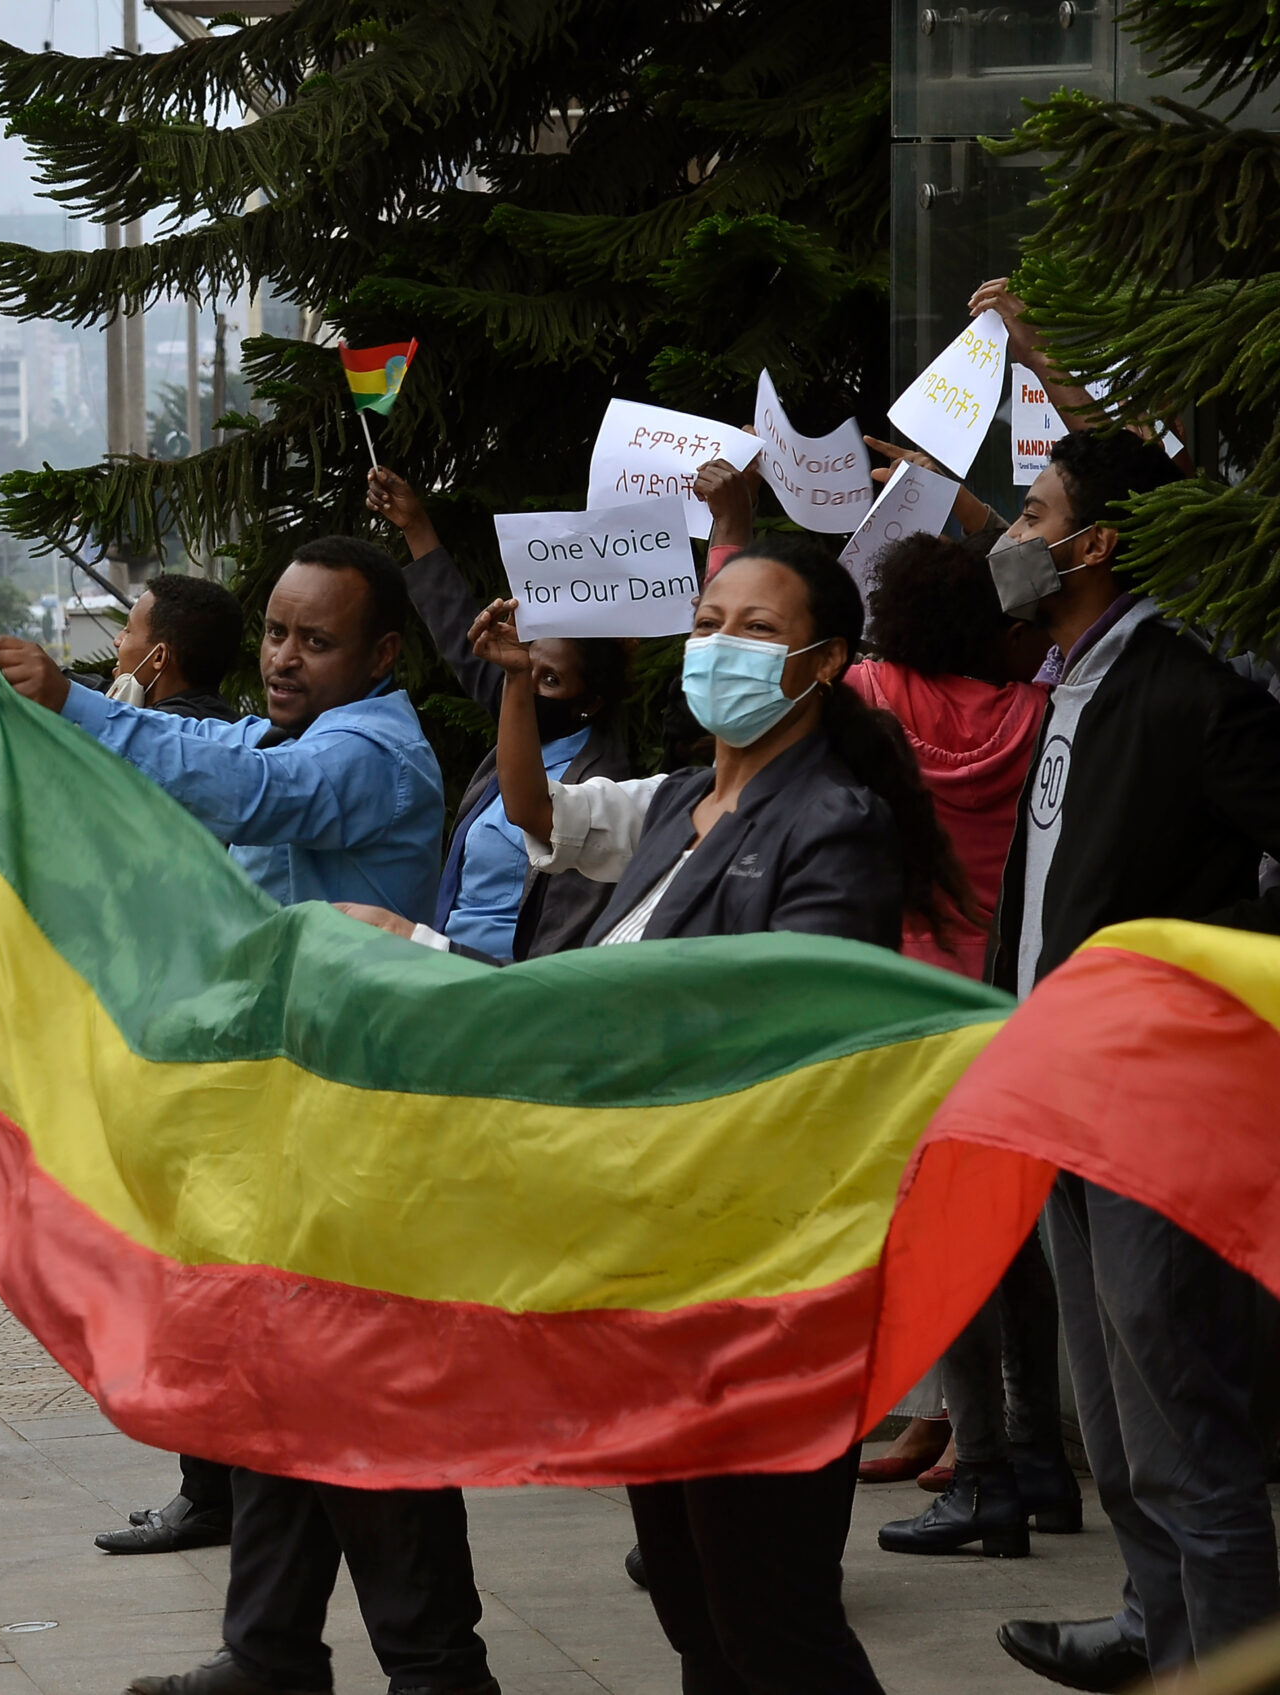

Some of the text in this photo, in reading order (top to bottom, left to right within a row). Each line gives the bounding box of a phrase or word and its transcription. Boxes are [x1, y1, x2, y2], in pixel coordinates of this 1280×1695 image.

[1022, 384, 1045, 403] Face
[1044, 413, 1051, 429] Is
[764, 408, 787, 455] One
[791, 446, 856, 474] Voice
[772, 461, 869, 506] Our Dam
[527, 529, 670, 562] One Voice
[524, 575, 695, 603] for Our Dam
[1040, 755, 1064, 810] 90
